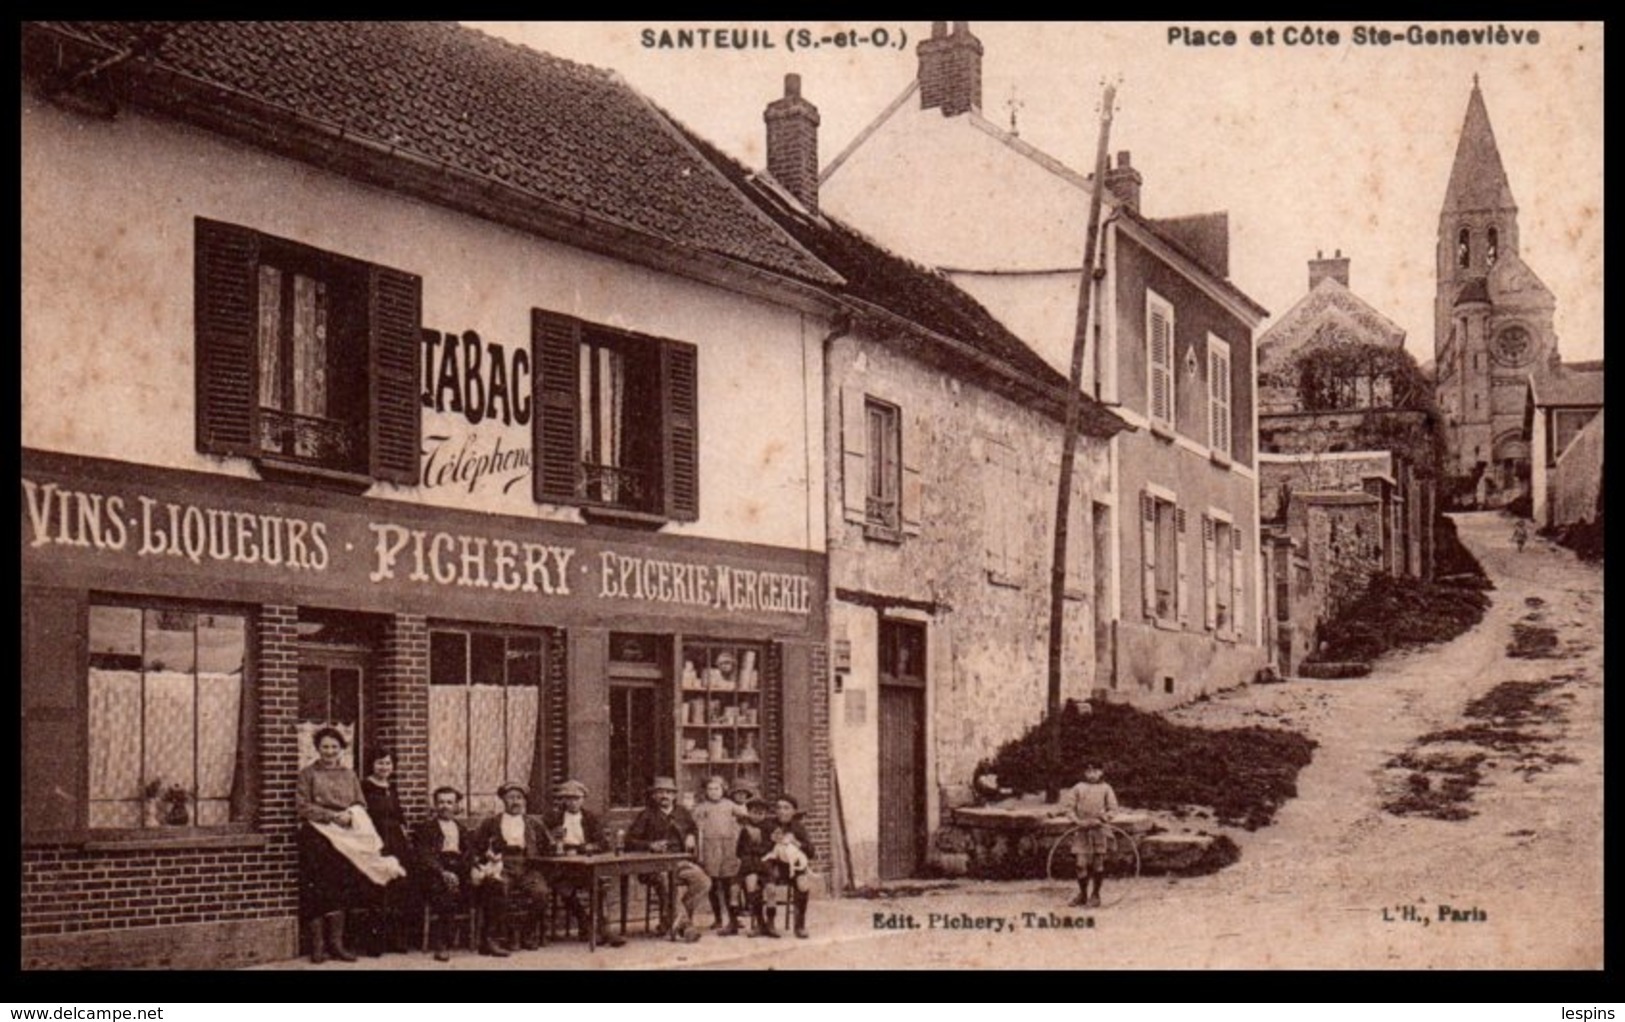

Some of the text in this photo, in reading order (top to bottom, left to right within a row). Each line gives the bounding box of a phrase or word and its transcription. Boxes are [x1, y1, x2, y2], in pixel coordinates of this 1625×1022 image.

[421, 328, 531, 426] TABAC
[22, 480, 124, 551] VINS
[138, 495, 329, 571] LIQUEURS
[369, 522, 577, 595] PICHERY
